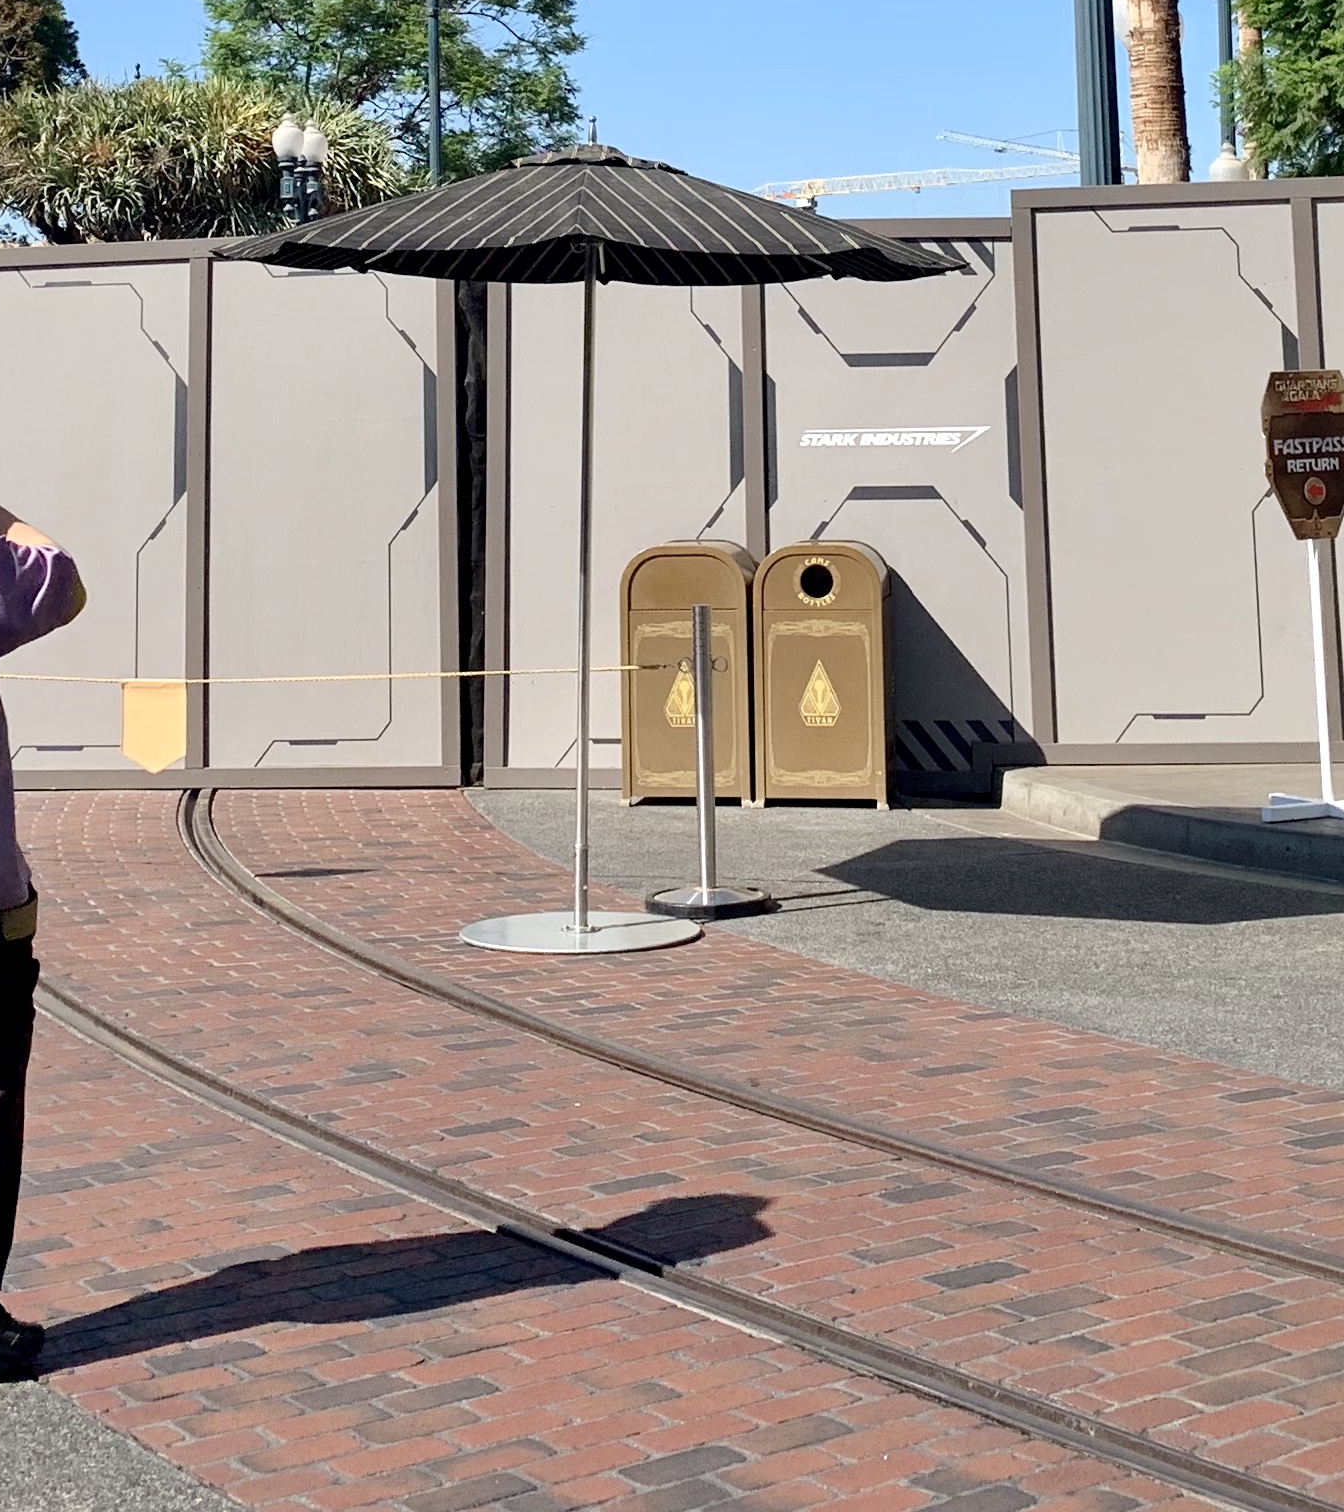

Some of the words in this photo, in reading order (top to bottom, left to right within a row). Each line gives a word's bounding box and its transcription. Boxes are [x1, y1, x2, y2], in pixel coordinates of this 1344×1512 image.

[800, 433, 858, 447] STARK
[860, 432, 961, 446] INDUSTRIES
[1287, 457, 1340, 473] RETURN
[797, 592, 836, 608] BOTTLES
